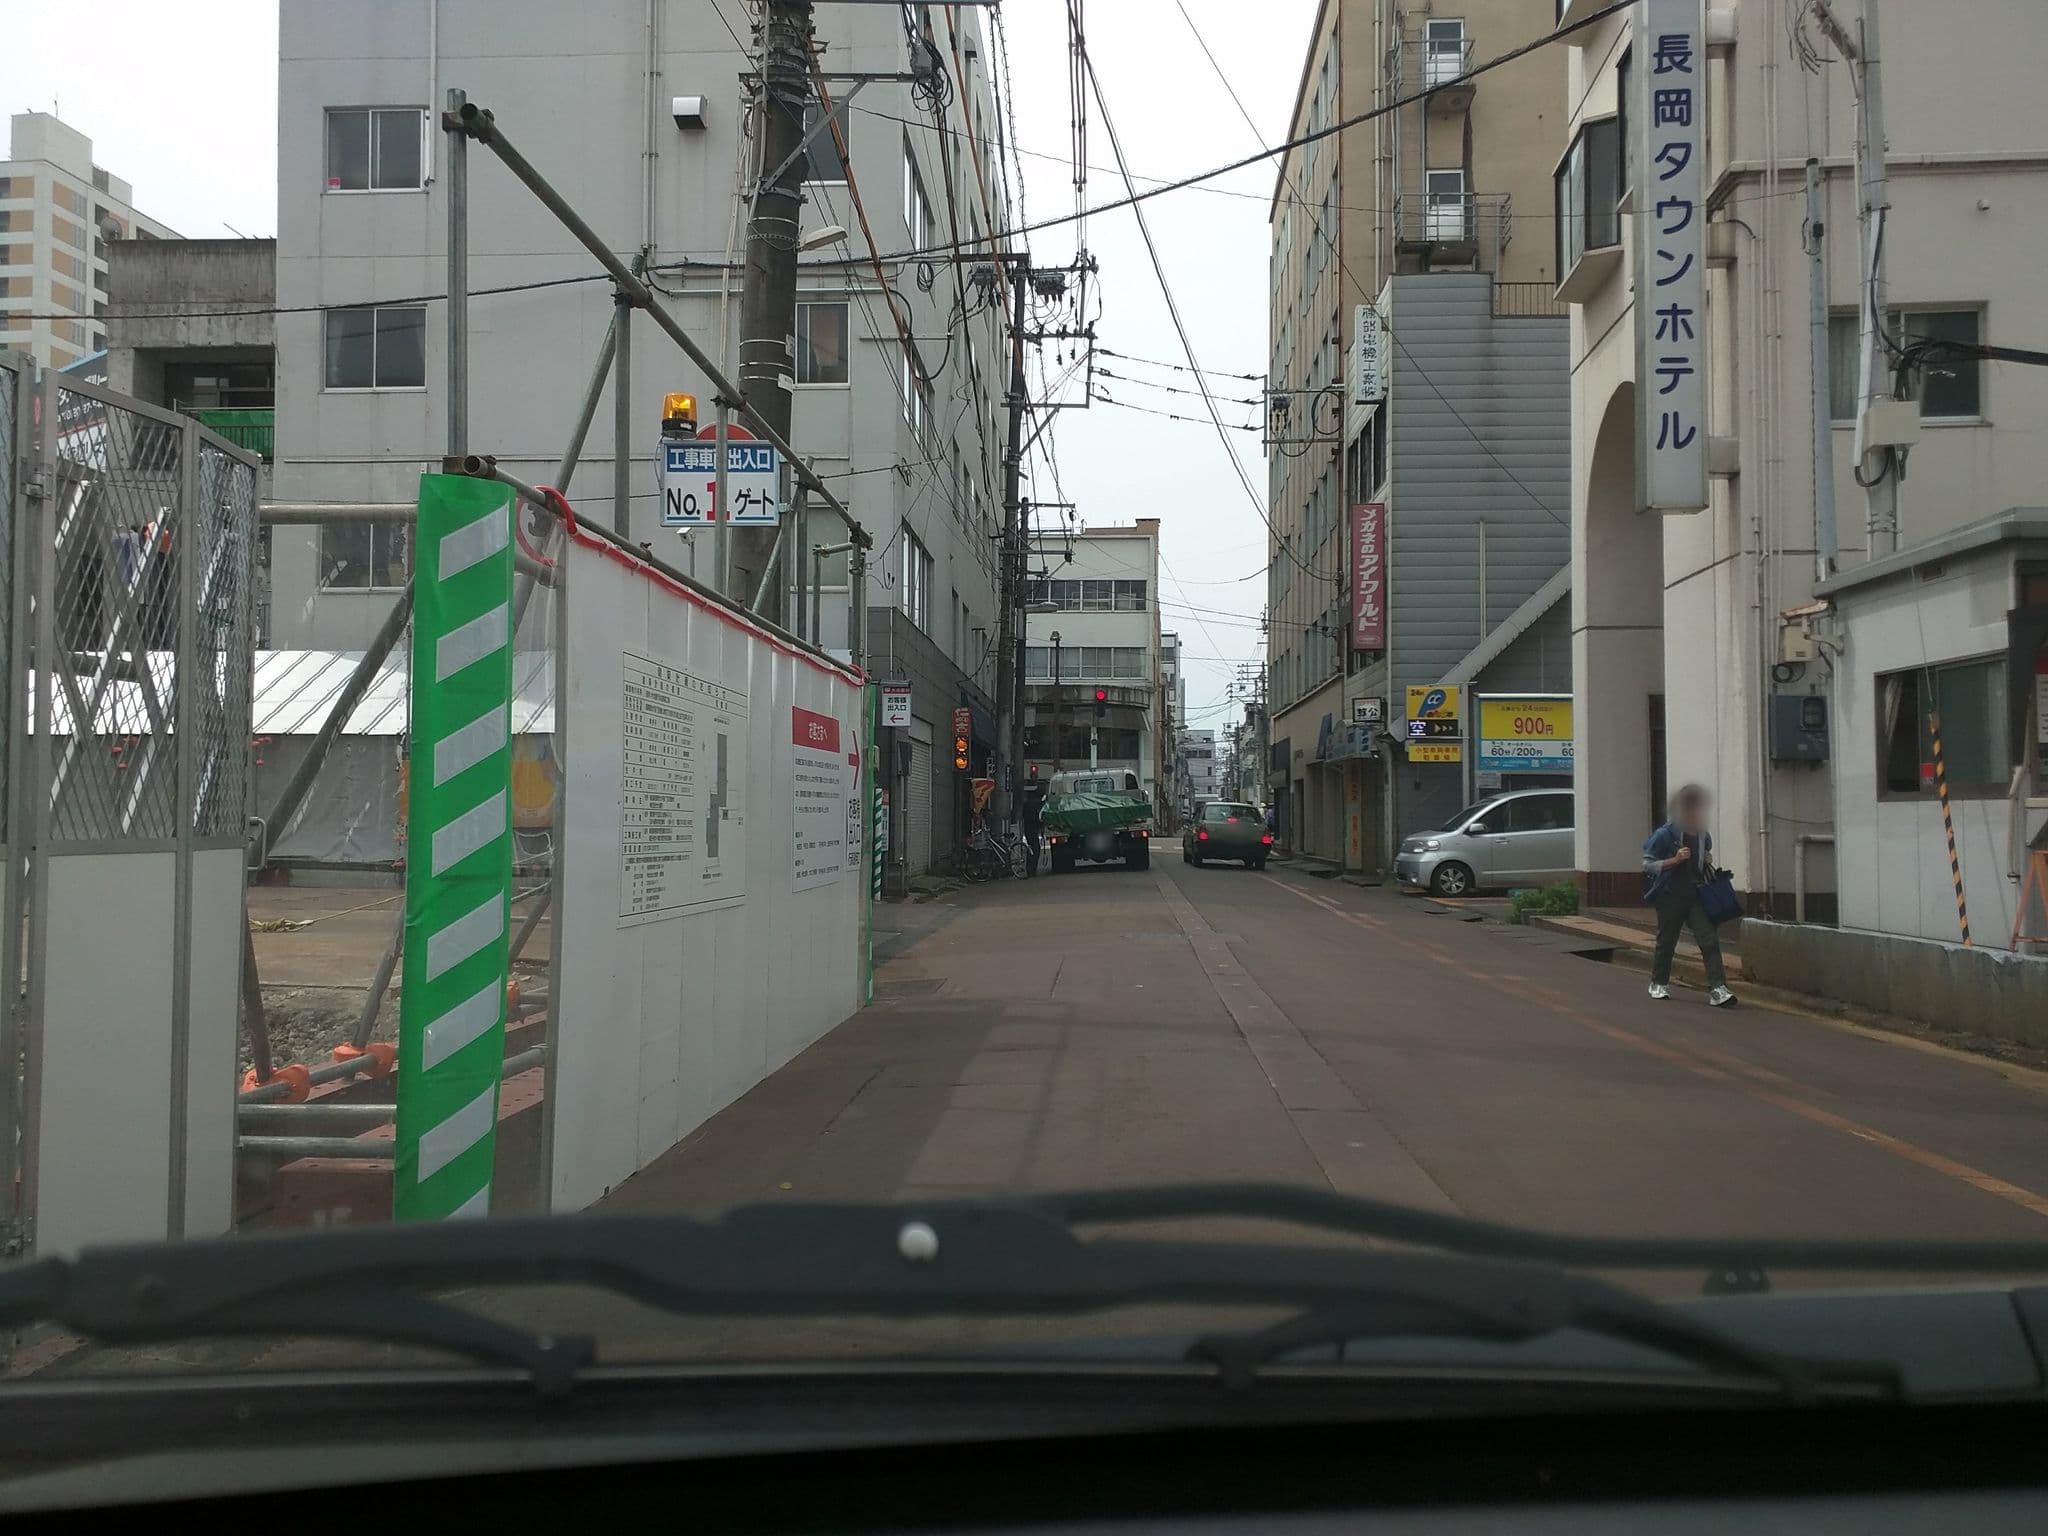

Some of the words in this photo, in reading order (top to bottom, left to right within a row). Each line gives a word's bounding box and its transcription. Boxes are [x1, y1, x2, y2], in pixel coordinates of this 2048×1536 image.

[1652, 34, 1696, 451] 長岡タウンホテル
[669, 448, 771, 470] 工事車出入口
[666, 488, 701, 516] No.
[734, 487, 774, 516] ゲート
[1358, 509, 1379, 632] メガネのアイワールド
[888, 704, 907, 712] 出入口
[1409, 720, 1427, 736] 空
[1514, 717, 1554, 736] 900円
